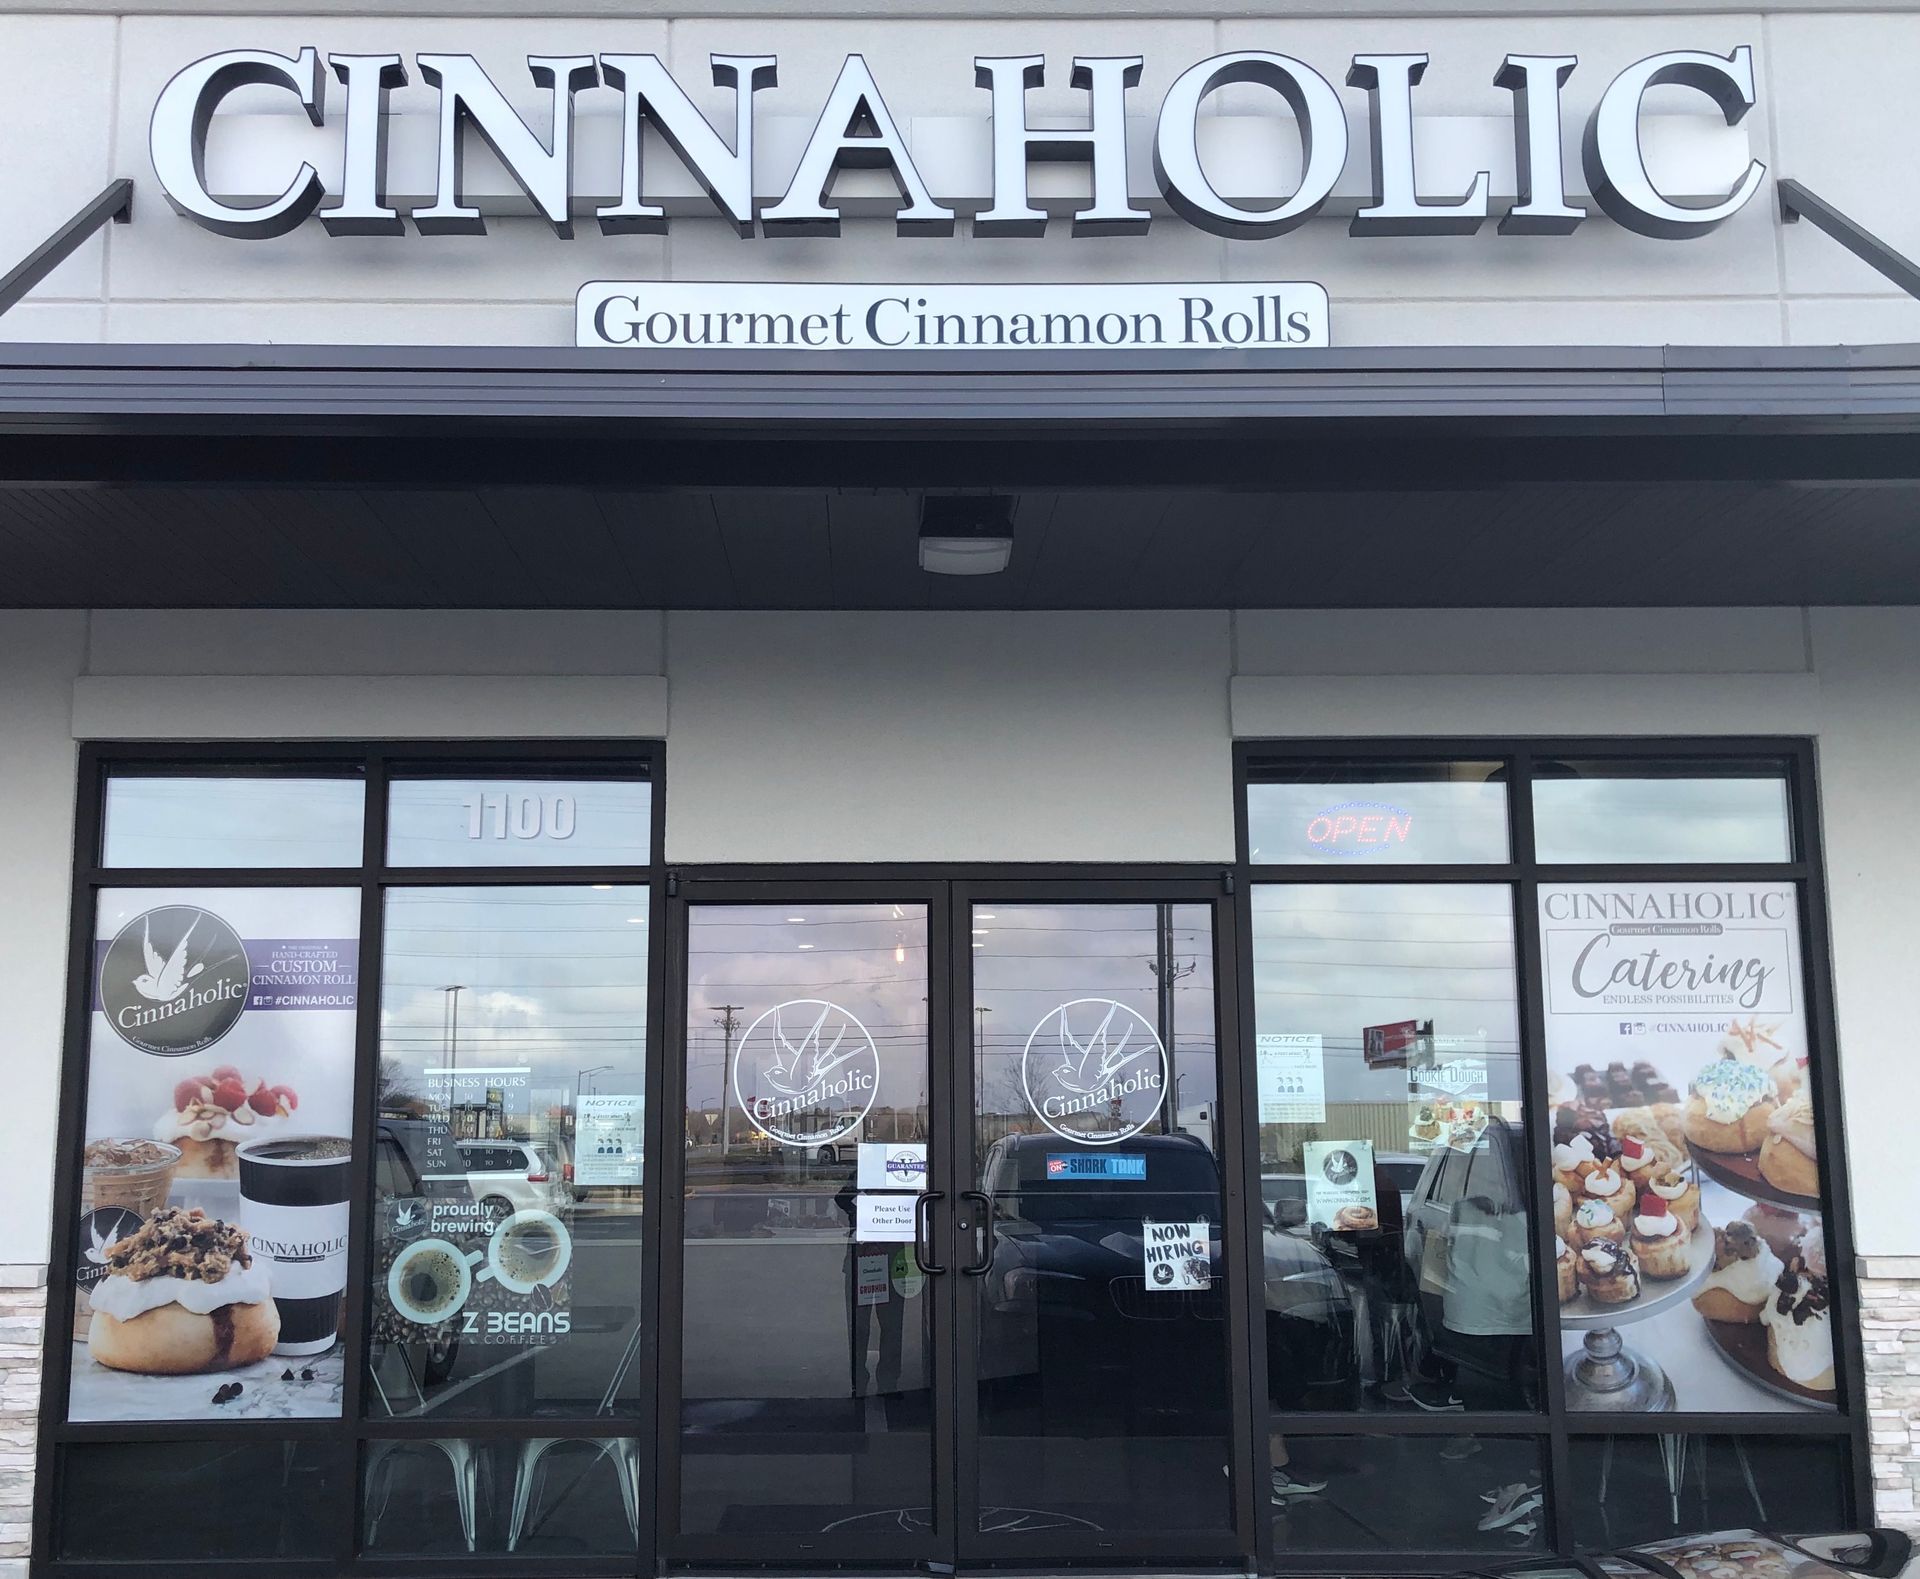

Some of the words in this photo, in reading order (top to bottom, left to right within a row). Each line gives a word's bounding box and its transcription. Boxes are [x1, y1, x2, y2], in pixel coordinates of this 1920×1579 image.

[149, 46, 1766, 236] CINNAHOLIC
[594, 295, 853, 346] Gourmet
[866, 297, 1166, 346] Cinnamon
[1178, 295, 1311, 344] Rolls
[462, 793, 576, 840] 1100
[1307, 816, 1413, 842] OPEN
[1544, 892, 1786, 921] CINNAHOLIC
[1611, 925, 1651, 935] Gourmet
[1652, 924, 1700, 935] Cinnamon
[1700, 923, 1721, 934] Rolls
[271, 951, 338, 959] HAND-CRAFTED
[271, 959, 338, 973] CUSTOM
[1572, 933, 1775, 1009] Catering
[252, 974, 321, 985] CINNAMON
[323, 974, 356, 985] ROLL
[118, 978, 243, 1029] Cinnaholic
[275, 995, 355, 1005] #CINNAHOLIC
[1602, 994, 1653, 1005] ENDLESS
[1655, 994, 1735, 1005] POSSIBILITIES
[1261, 1035, 1314, 1043] NOTICE
[428, 1078, 480, 1088] BUSINESS
[485, 1077, 527, 1087] HOURS
[428, 1092, 451, 1101] MON
[753, 1069, 873, 1121] Cinnaholic
[1043, 1068, 1161, 1120] Cinnaholic
[585, 1099, 635, 1107] NOTICE
[428, 1126, 448, 1135] THU
[427, 1137, 441, 1146] FRI
[426, 1148, 444, 1157] SAT
[426, 1159, 447, 1168] SUN
[1050, 1164, 1063, 1173] ON
[1070, 1158, 1107, 1174] SHARK
[1111, 1158, 1144, 1174] TANK
[433, 1202, 494, 1219] proudly
[430, 1220, 494, 1236] brewing
[872, 1217, 893, 1225] Other
[895, 1217, 913, 1225] Door
[1151, 1223, 1191, 1242] NOW
[252, 1234, 347, 1256] CINNAHOLIC
[1146, 1240, 1204, 1263] HIRING
[462, 1311, 479, 1334] Z
[487, 1311, 571, 1334] BEANS
